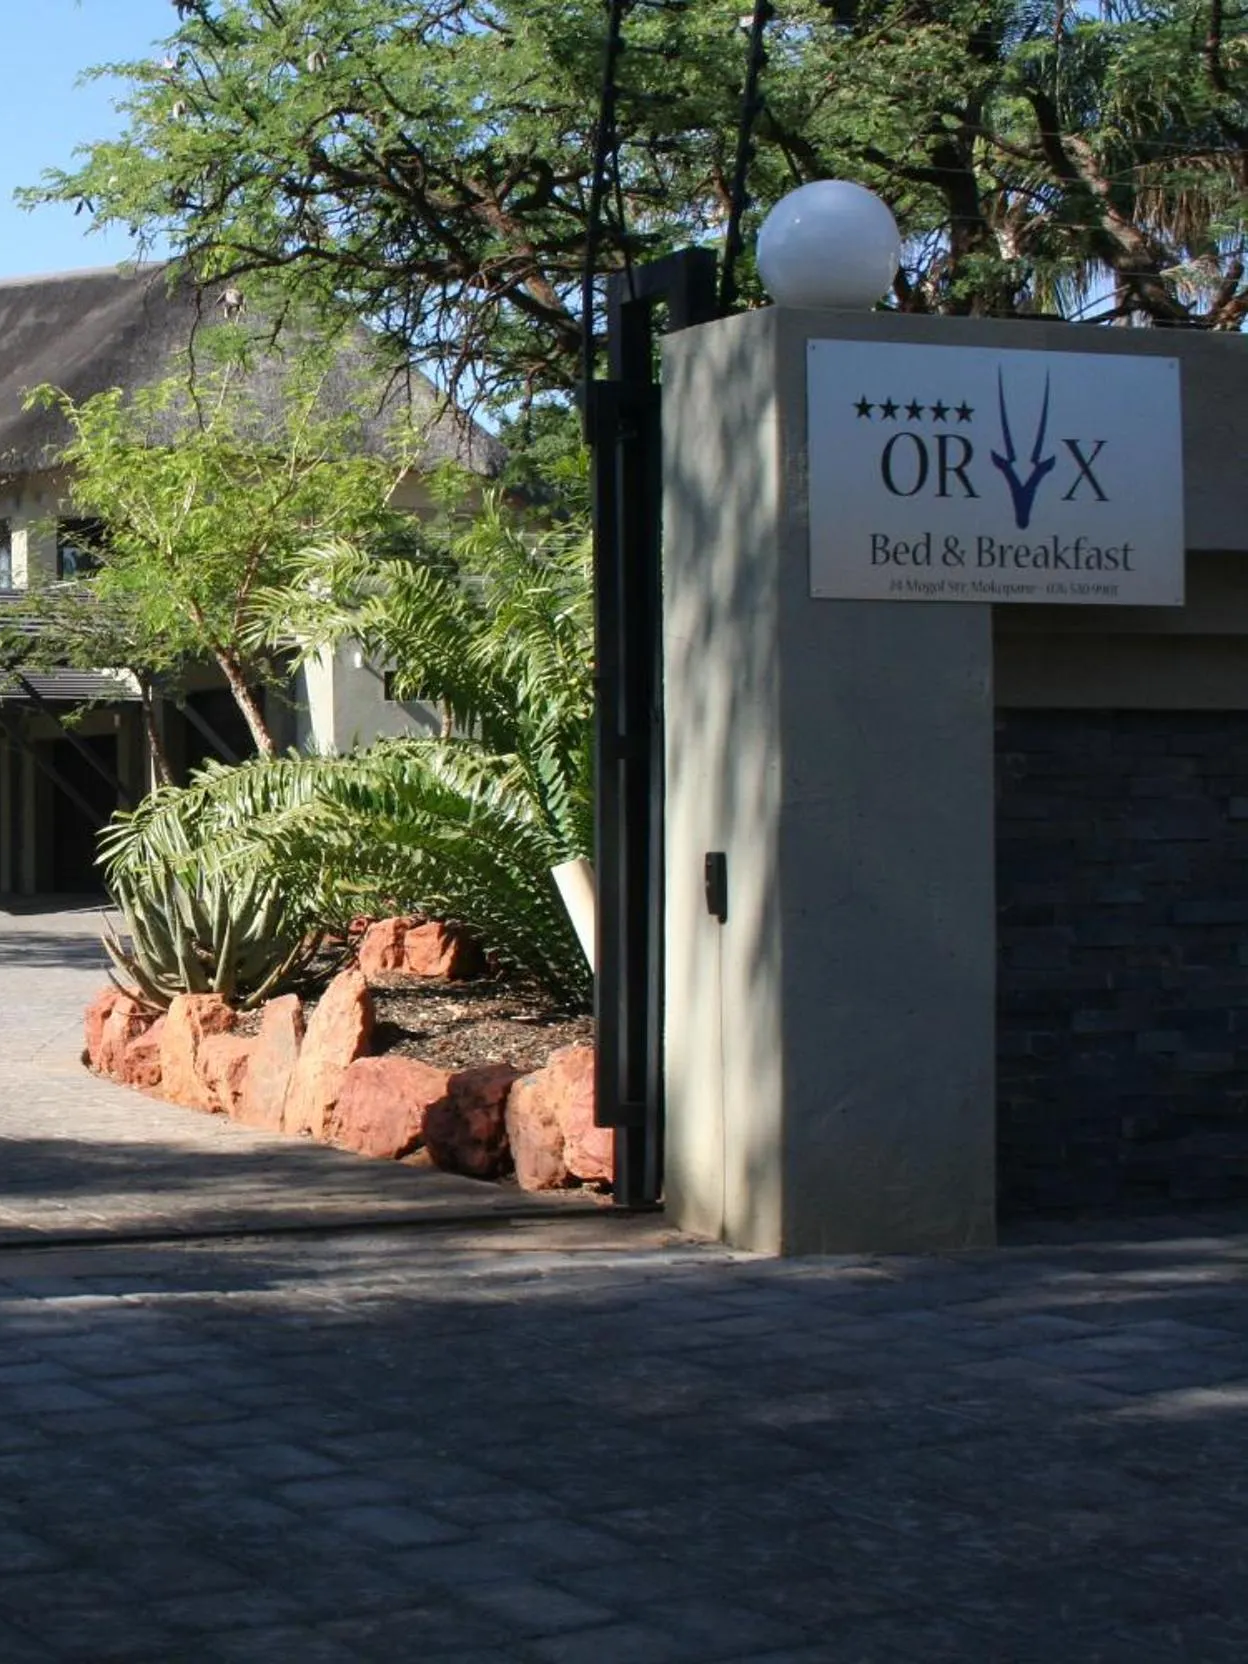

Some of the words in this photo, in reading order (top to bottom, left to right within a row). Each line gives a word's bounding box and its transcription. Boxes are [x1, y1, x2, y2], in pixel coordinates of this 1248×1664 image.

[869, 532, 932, 567] Bed
[941, 534, 967, 567] &
[975, 534, 1136, 572] Breakfast
